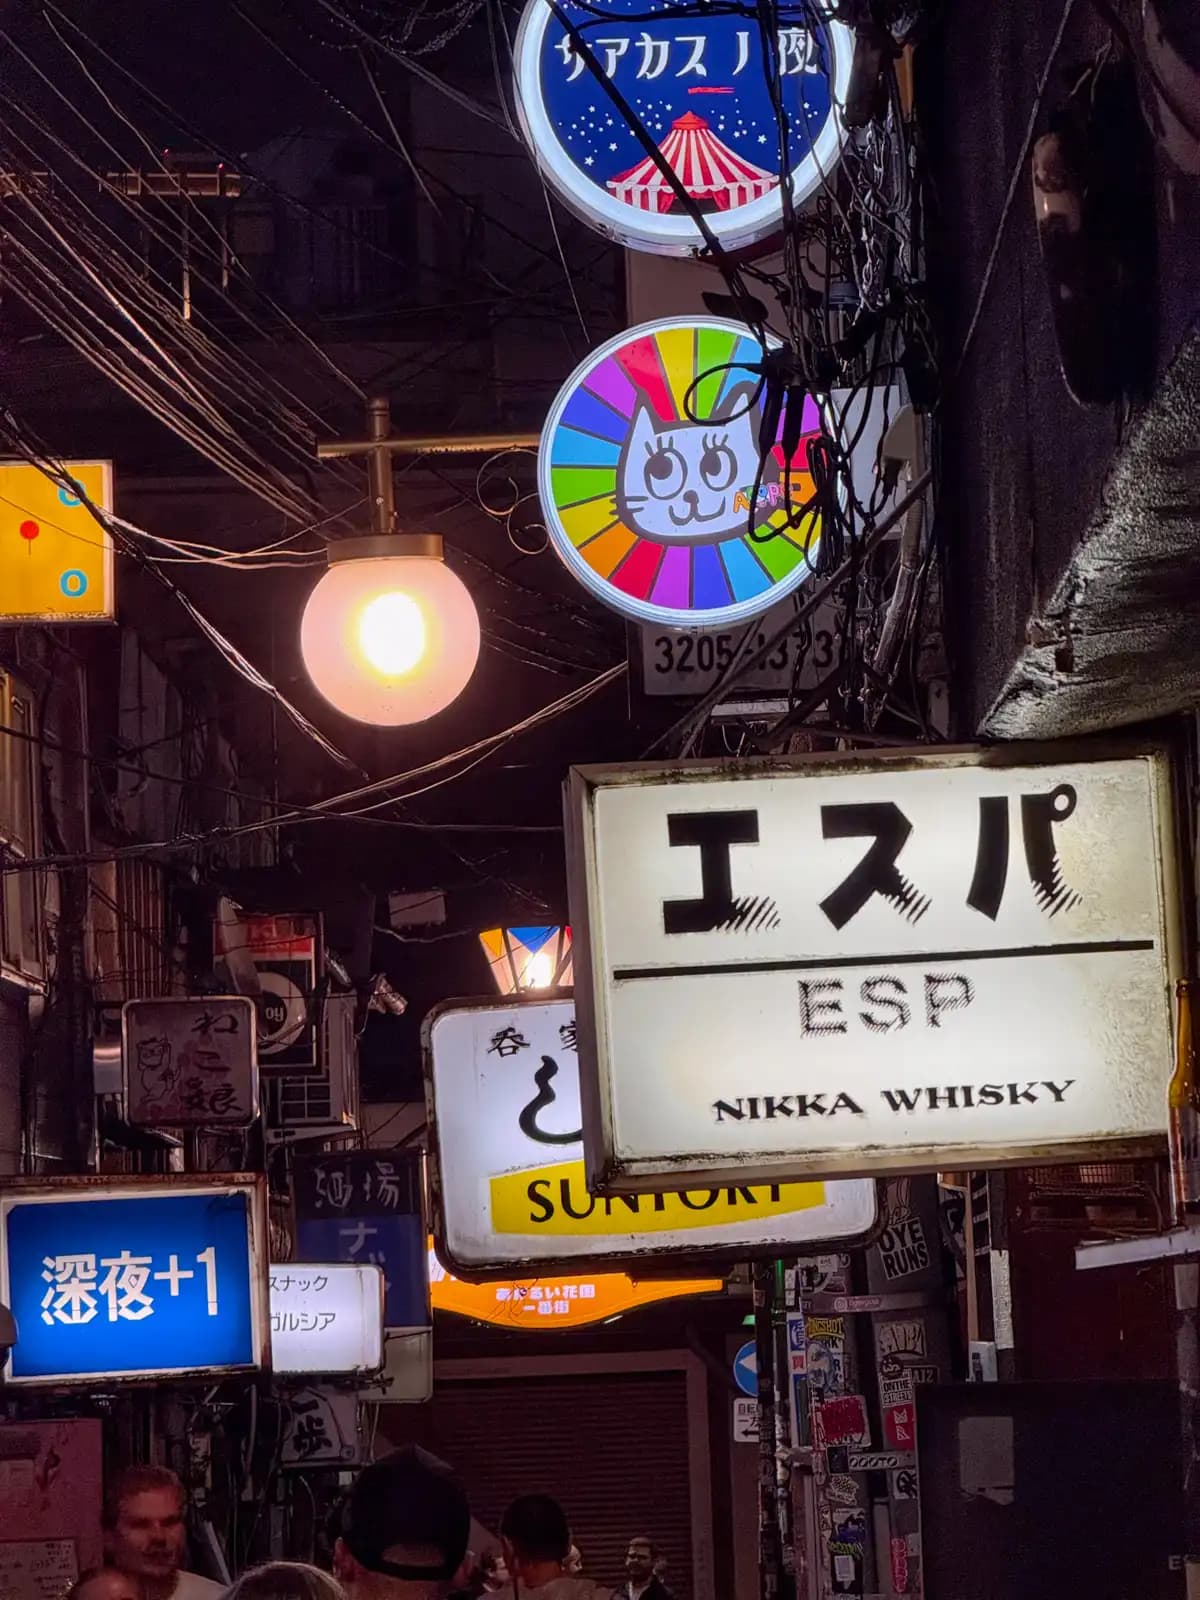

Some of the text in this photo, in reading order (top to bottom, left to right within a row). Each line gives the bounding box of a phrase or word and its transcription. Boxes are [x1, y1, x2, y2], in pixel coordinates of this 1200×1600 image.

[663, 783, 1082, 933] エスパ
[799, 971, 975, 1039] ESP
[713, 1080, 1076, 1123] NIKKA WHISKY
[41, 1246, 218, 1326] 深夜+1
[269, 1275, 328, 1291] スナック
